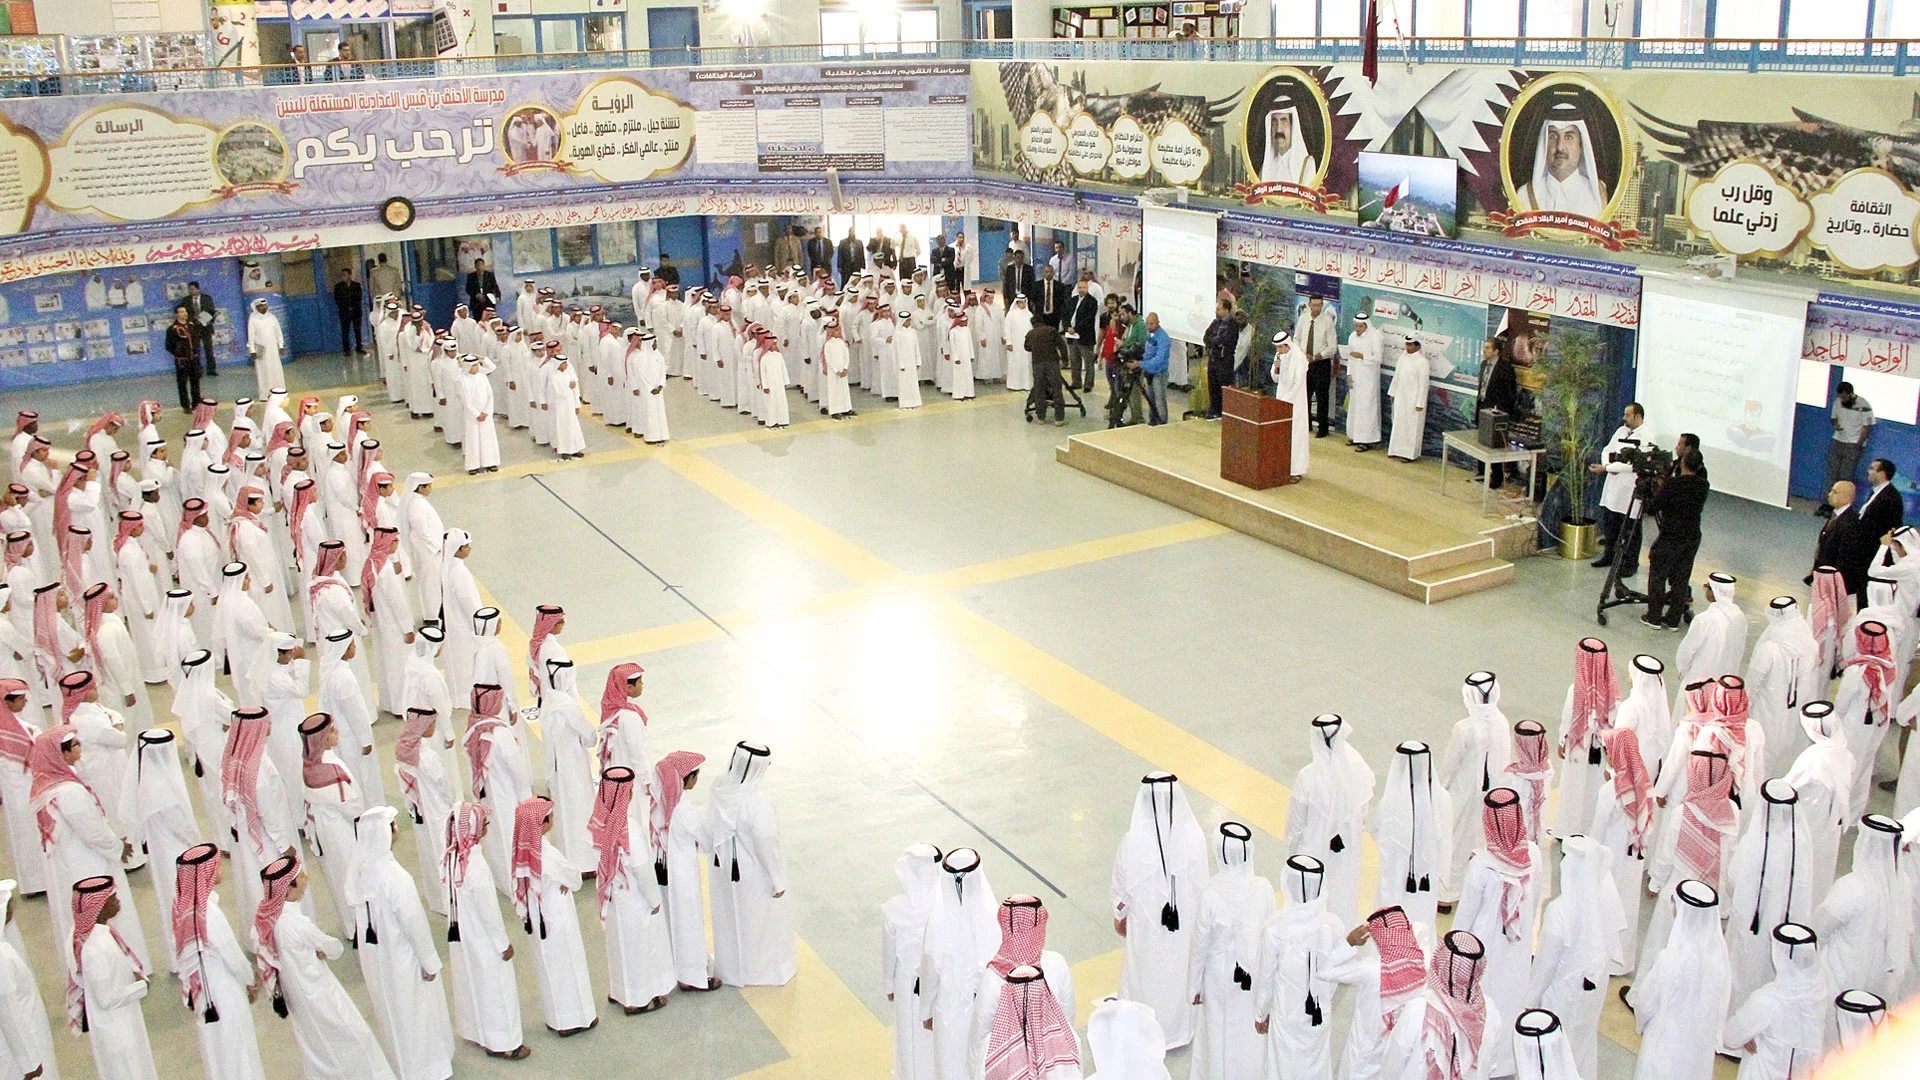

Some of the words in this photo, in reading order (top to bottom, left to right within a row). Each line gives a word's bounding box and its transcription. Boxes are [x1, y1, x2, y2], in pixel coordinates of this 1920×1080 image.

[309, 94, 357, 112] المستقلة
[402, 90, 426, 110] قيس
[428, 90, 440, 109] بن
[473, 88, 504, 105] مدرسة
[277, 96, 307, 118] للبنين
[95, 119, 144, 135] الرسالة
[572, 122, 588, 138] فاعل
[595, 121, 616, 136] متفوق
[623, 120, 641, 135] ملتزم
[648, 119, 659, 133] جيل
[661, 117, 680, 129] تنشئة
[385, 118, 495, 168] ترحب
[596, 143, 615, 160] قطري
[622, 141, 638, 157] الفكر
[640, 141, 658, 160] عالمي
[664, 139, 679, 156] منتج
[293, 127, 378, 179] بكم
[1721, 184, 1741, 202] رب
[1743, 184, 1773, 205] وقل
[827, 197, 859, 214] الصور
[1850, 200, 1892, 216] الثقافة
[1538, 214, 1554, 223] البلاد
[1554, 215, 1568, 224] أمير
[1568, 218, 1589, 229] السمو
[1713, 206, 1744, 225] علما
[1747, 212, 1778, 235] زدني
[1589, 224, 1610, 238] صاحب
[1826, 218, 1862, 235] وتاريخ
[1873, 221, 1909, 238] حضارة
